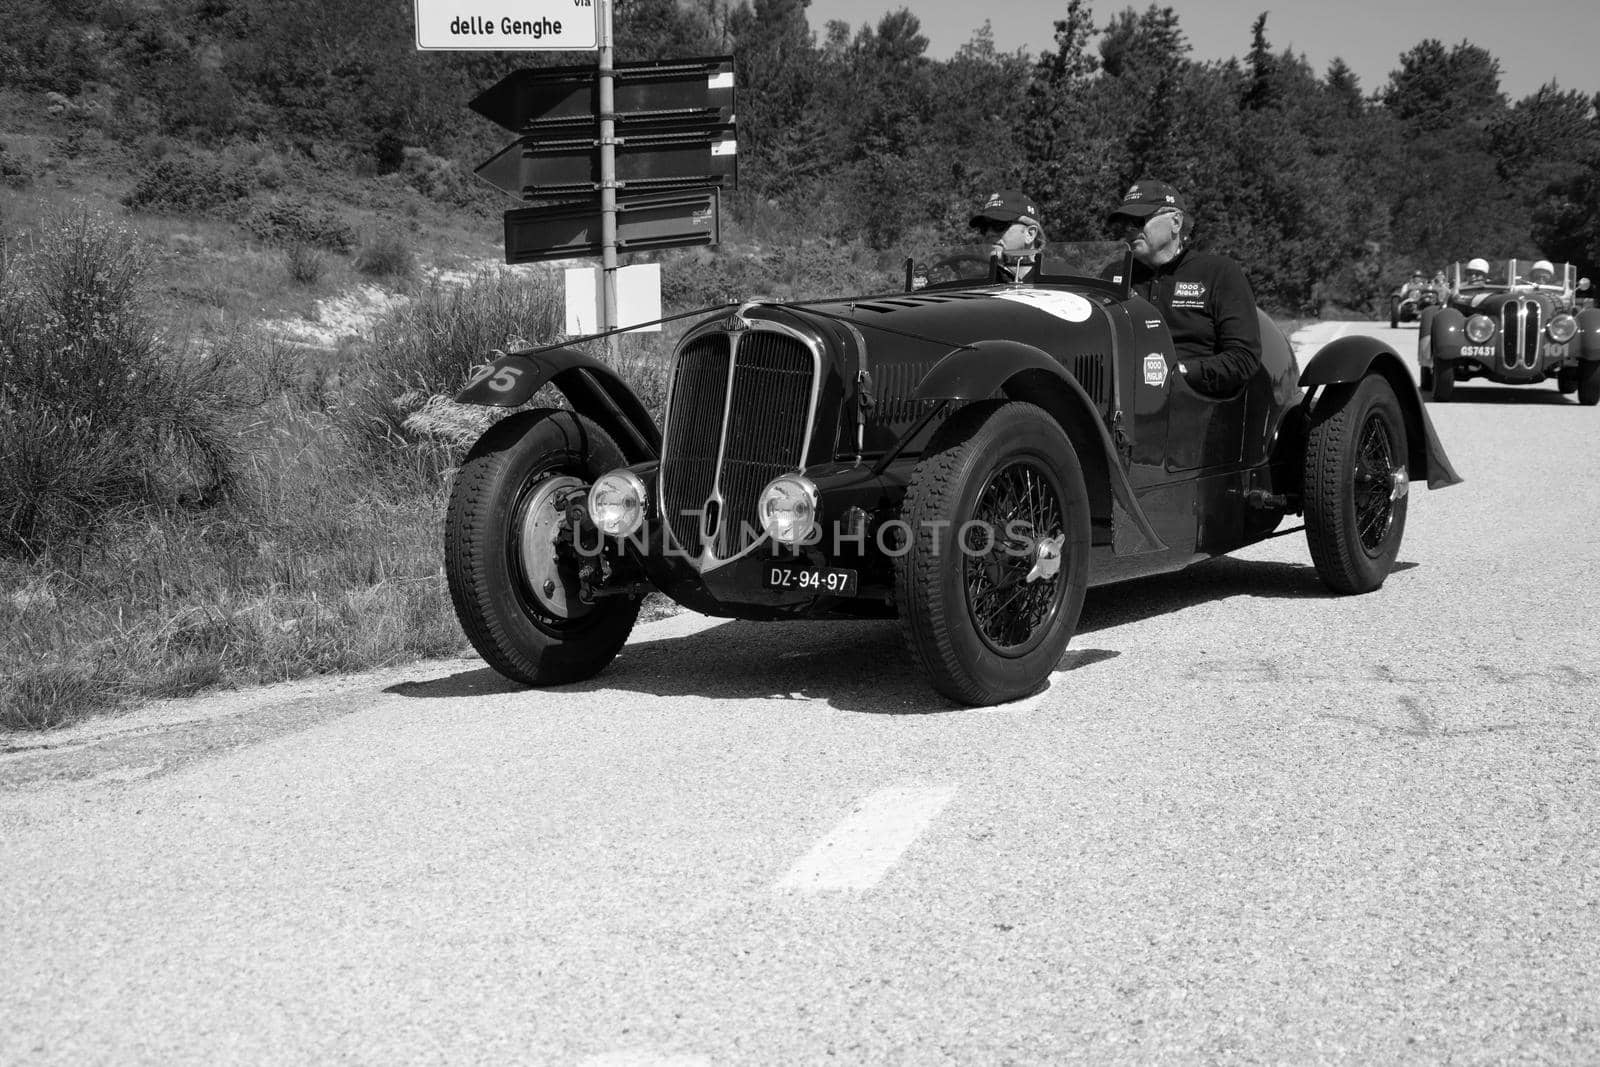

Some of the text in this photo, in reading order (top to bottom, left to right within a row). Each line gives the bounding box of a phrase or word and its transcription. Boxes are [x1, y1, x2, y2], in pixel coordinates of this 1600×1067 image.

[450, 16, 562, 39] delle Genghe
[1543, 343, 1569, 357] 101
[1147, 361, 1162, 370] 1000
[771, 569, 848, 591] DZ-94-97
